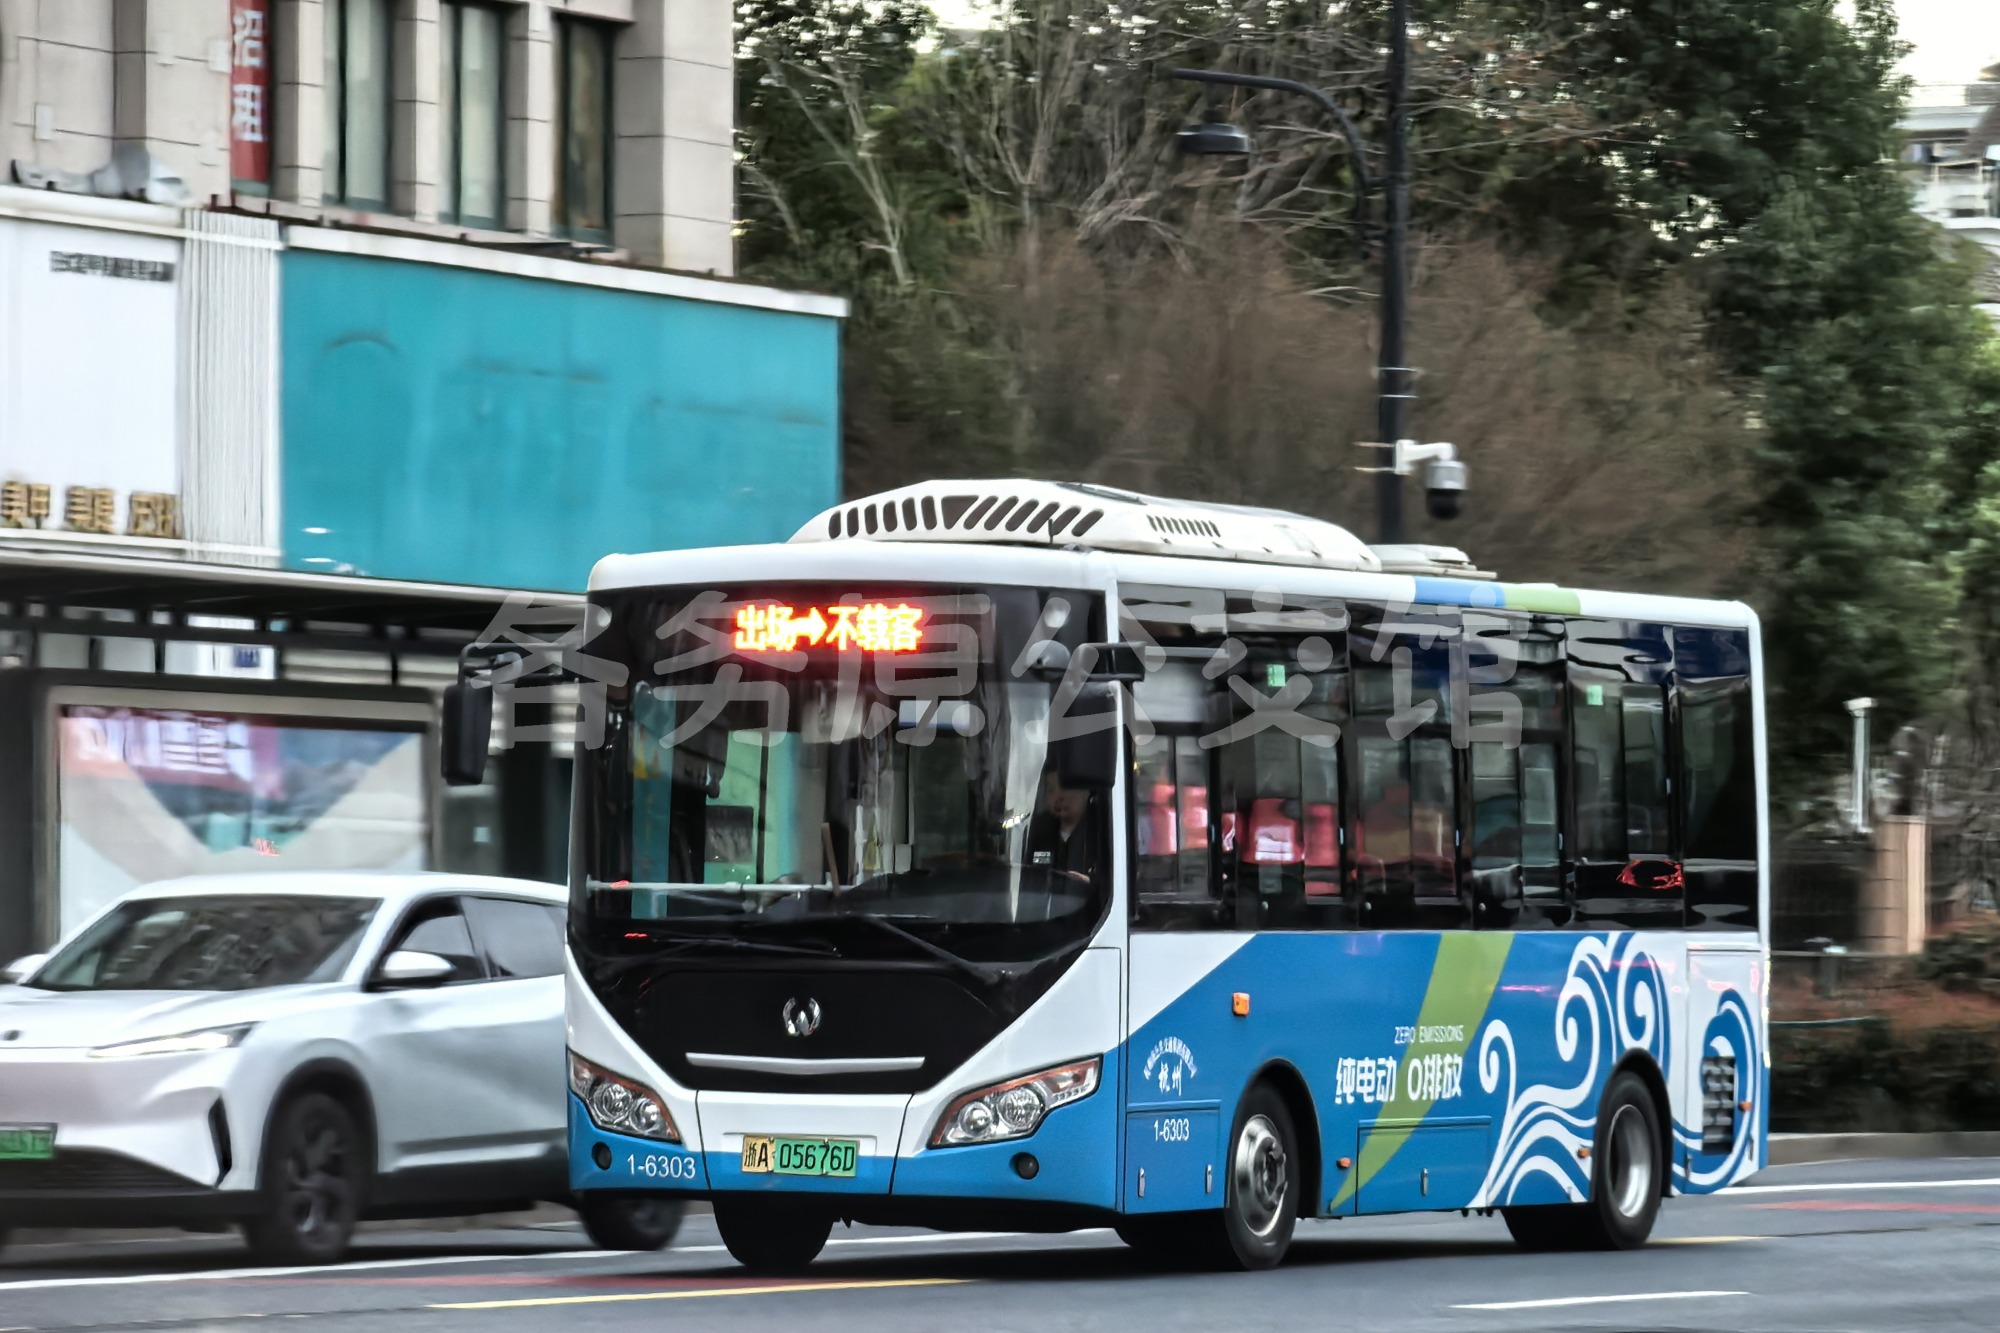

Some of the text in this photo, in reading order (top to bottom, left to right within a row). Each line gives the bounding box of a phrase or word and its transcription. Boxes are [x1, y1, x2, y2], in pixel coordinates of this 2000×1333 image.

[735, 603, 923, 651] 出场 不载客
[1394, 1026, 1415, 1044] ZERO
[1335, 1056, 1397, 1104] 纯电动
[1153, 1118, 1190, 1141] 1-6303
[627, 1154, 696, 1178] 1-6303
